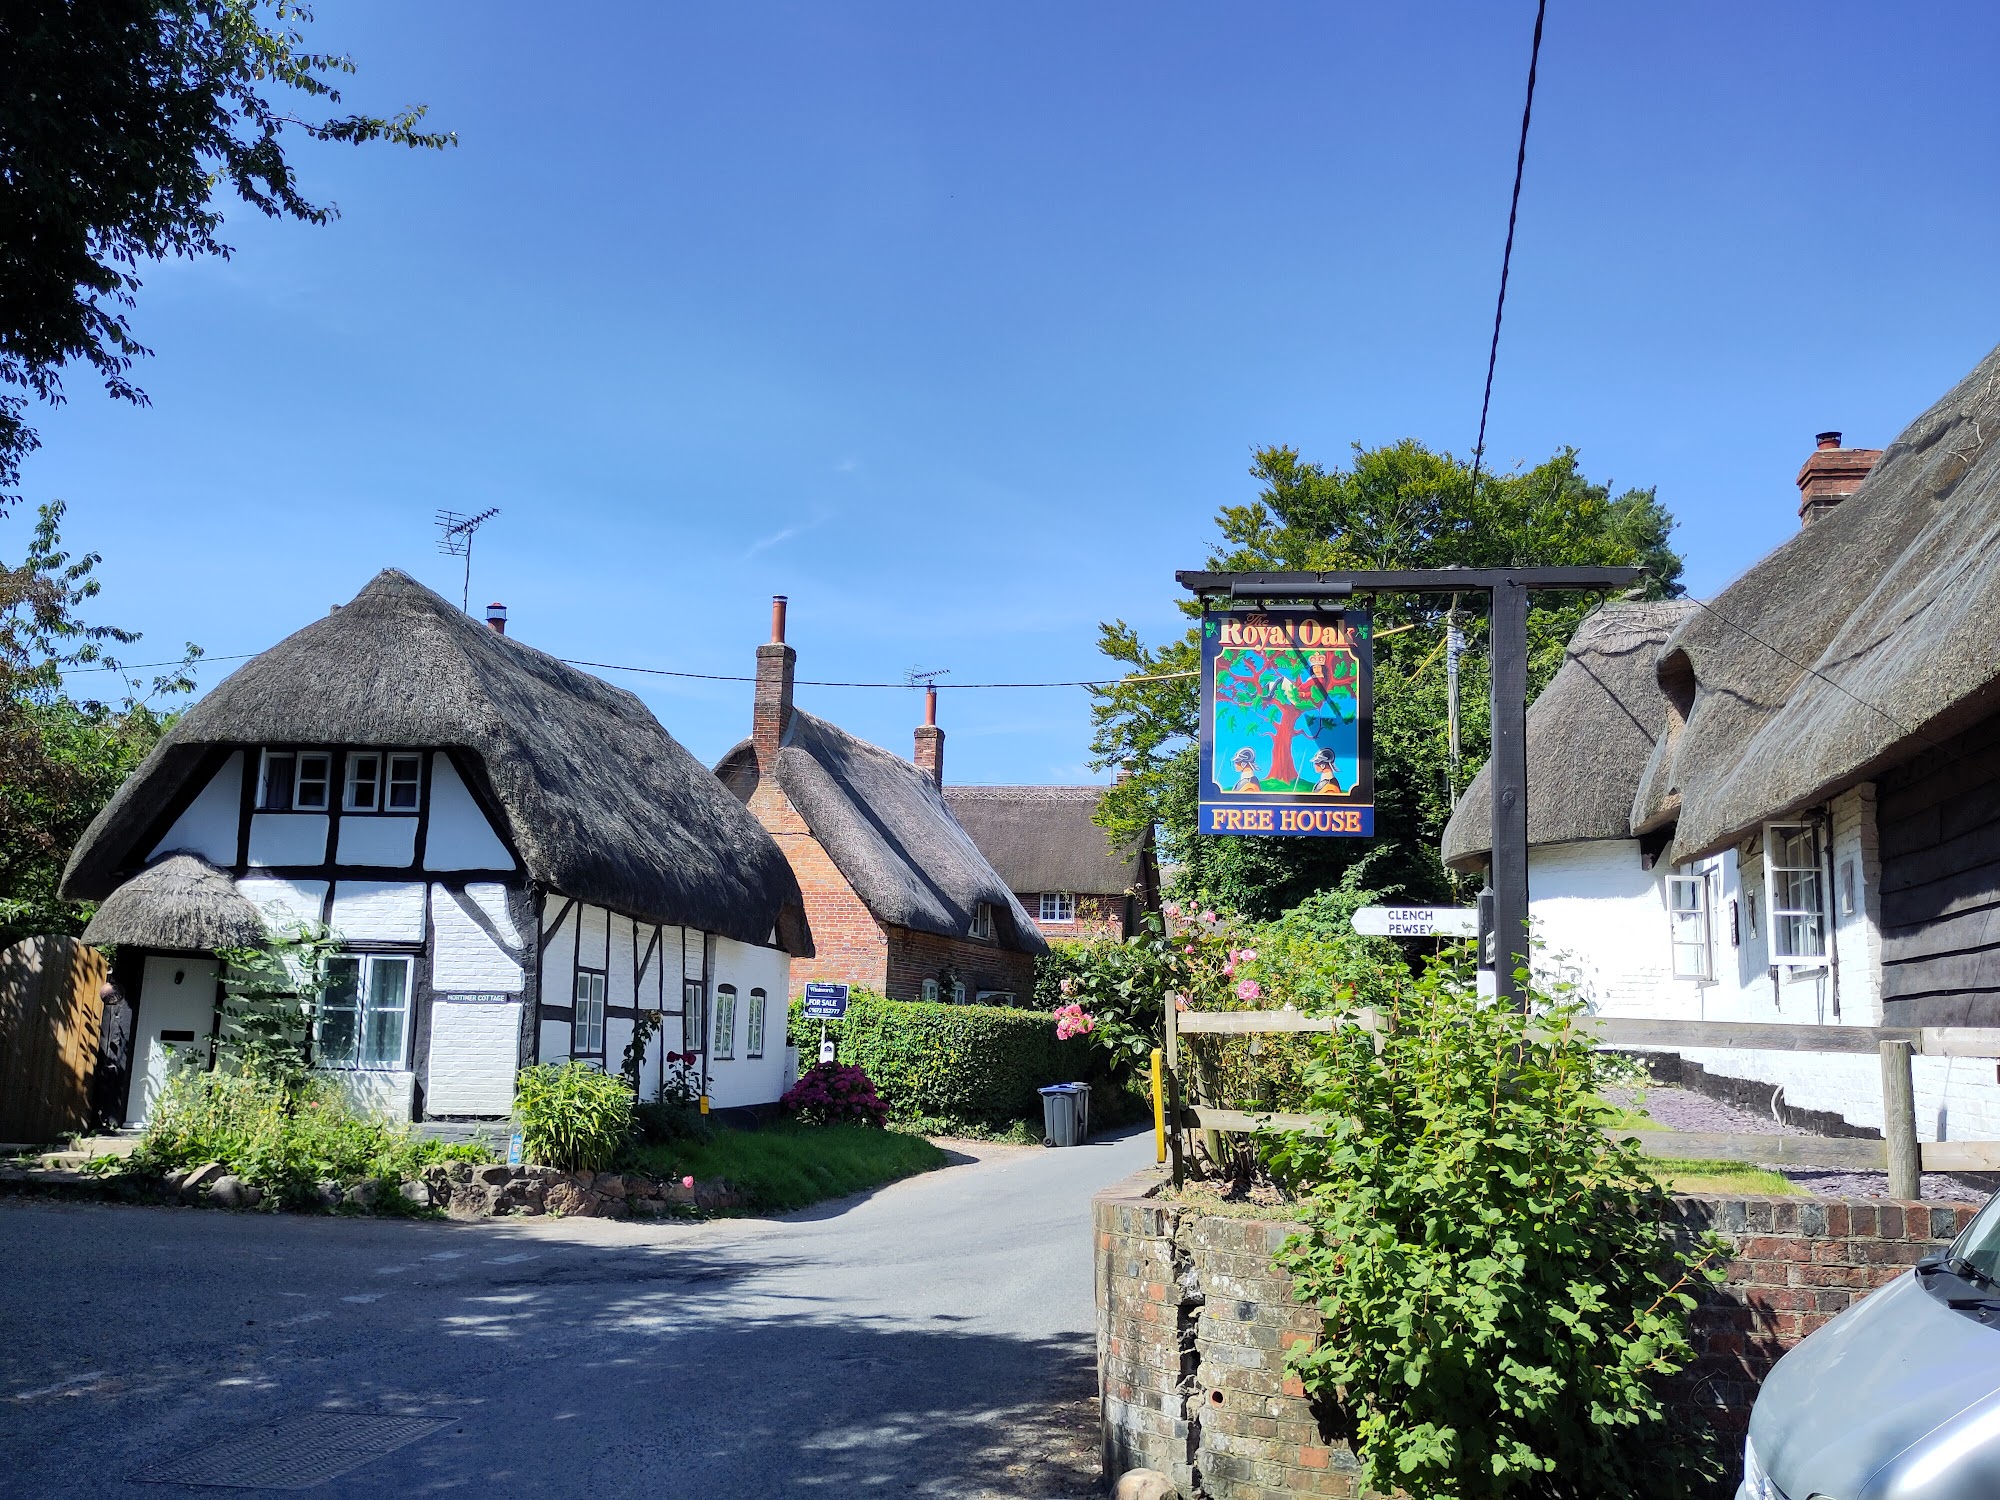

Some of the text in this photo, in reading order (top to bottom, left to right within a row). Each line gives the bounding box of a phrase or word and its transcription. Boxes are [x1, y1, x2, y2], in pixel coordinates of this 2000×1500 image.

[1244, 613, 1269, 626] The
[1218, 617, 1358, 651] Royal Oak
[1211, 809, 1362, 832] FREE HOUSE
[1388, 910, 1433, 921] CLENCH
[1388, 924, 1434, 934] PEWSEY
